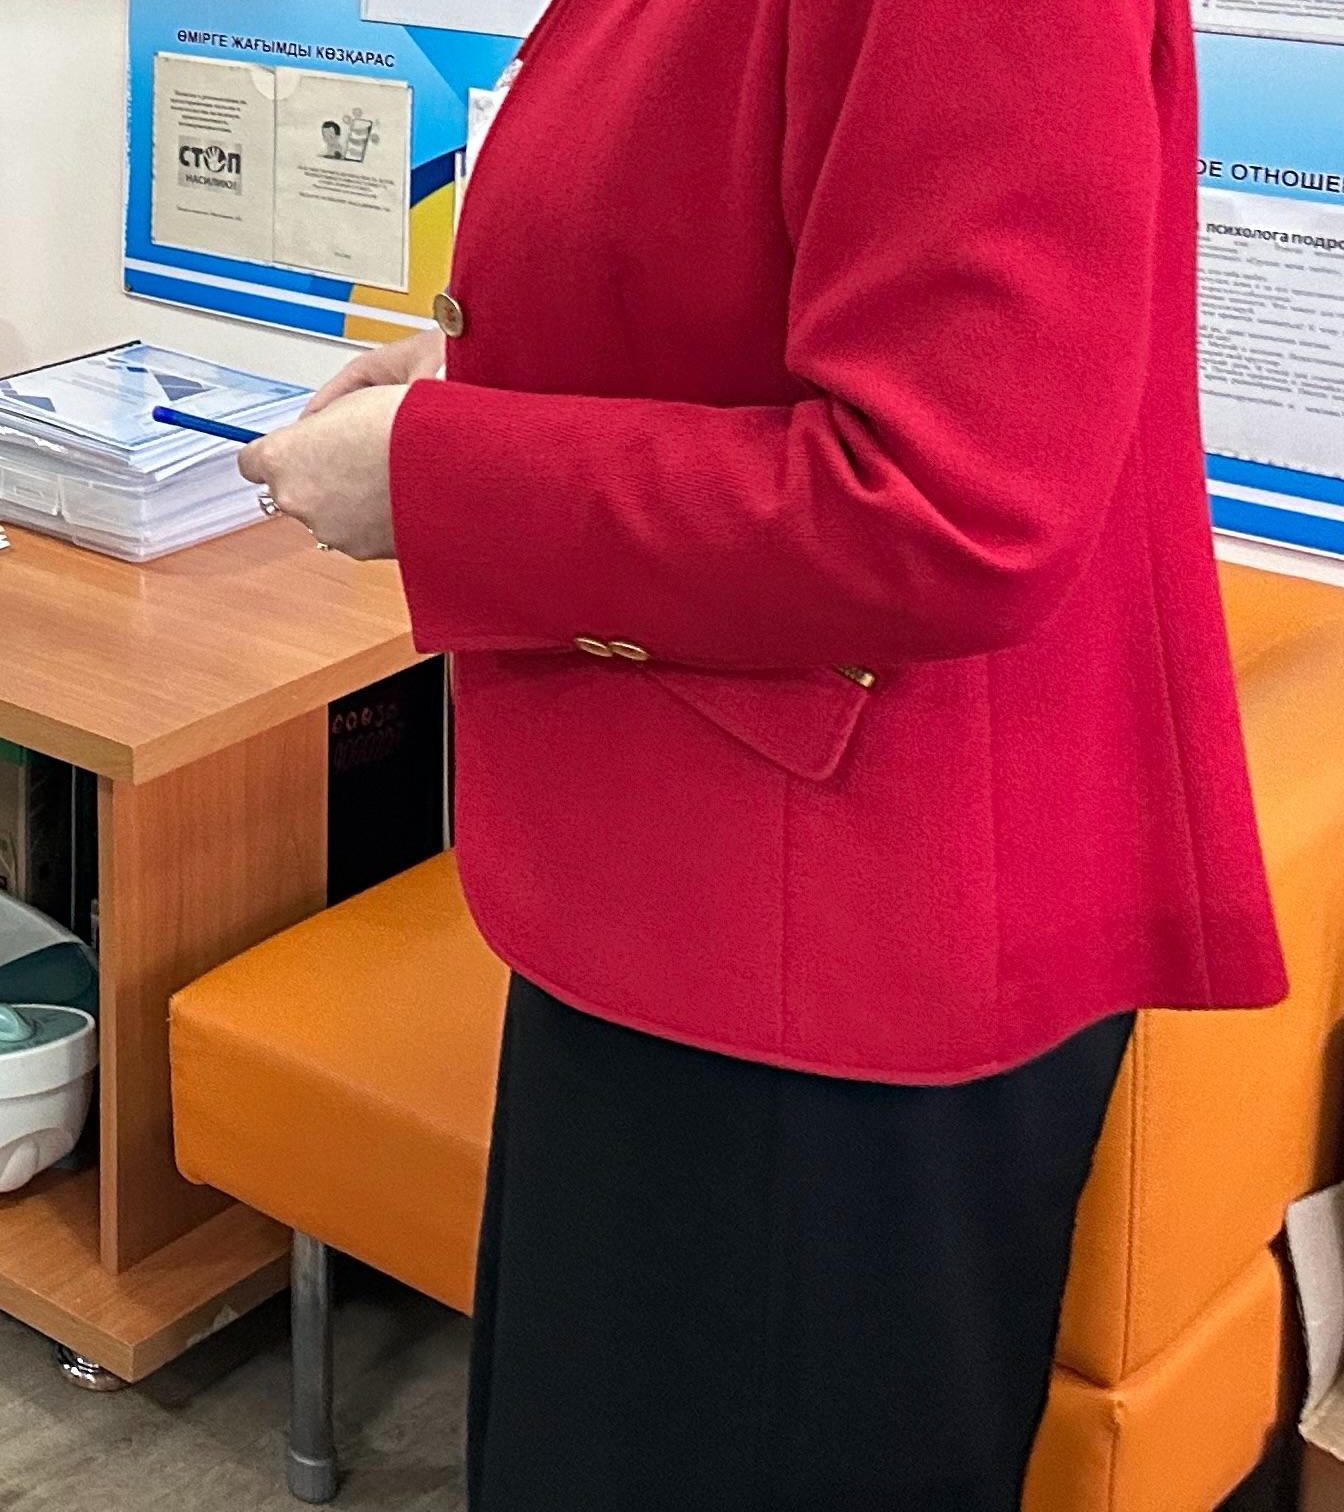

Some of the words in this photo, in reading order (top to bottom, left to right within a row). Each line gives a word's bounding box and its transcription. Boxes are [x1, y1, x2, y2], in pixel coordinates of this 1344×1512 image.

[177, 29, 228, 48] ӨМІРГЕ
[231, 34, 312, 58] ЖАҒЫМДЫ
[315, 45, 396, 69] КӨЗҚАРАС
[1231, 163, 1344, 193] ОТНОШЕ
[1206, 223, 1289, 243] психолога
